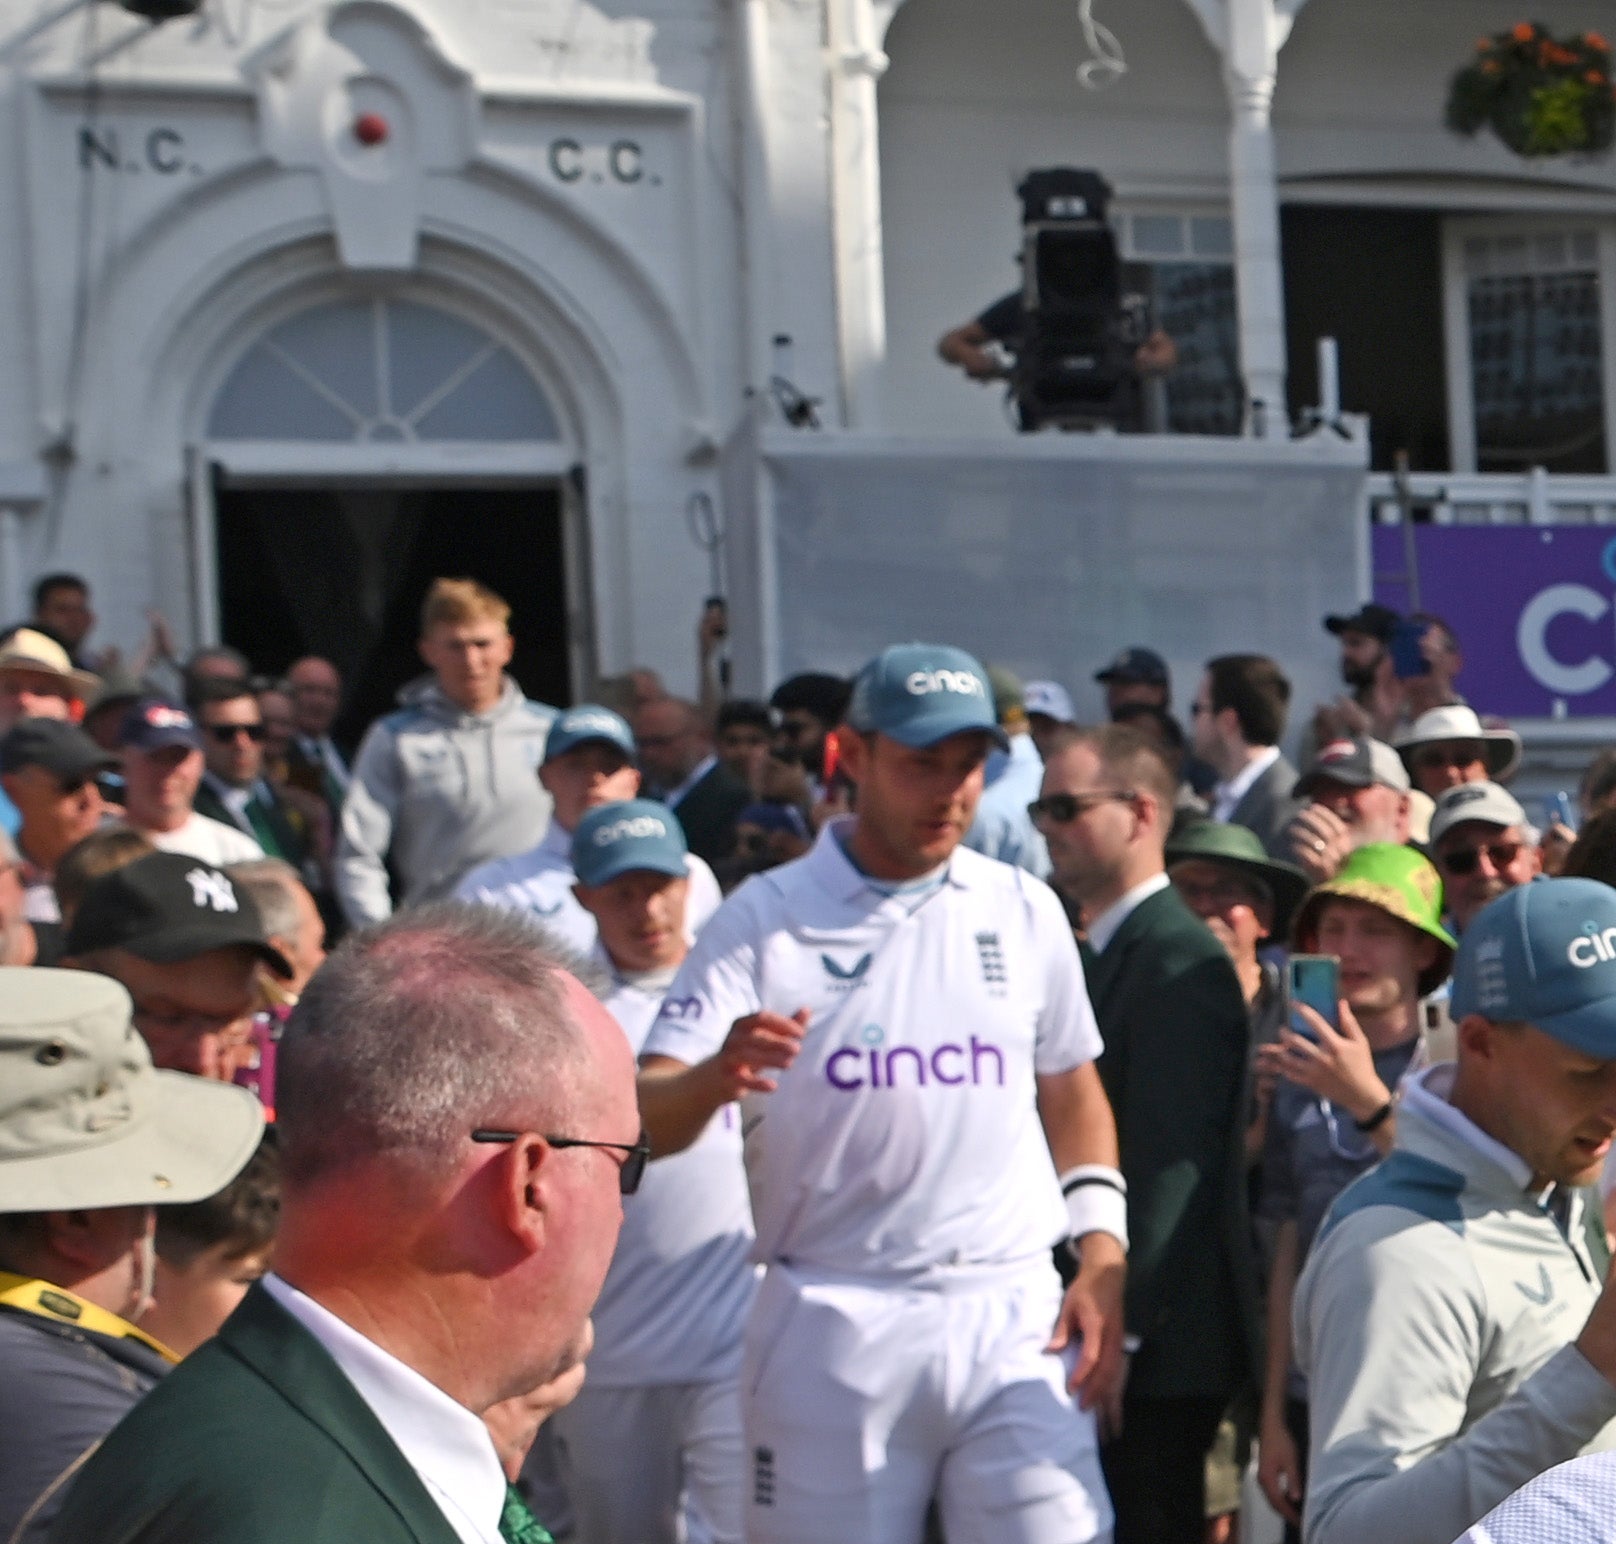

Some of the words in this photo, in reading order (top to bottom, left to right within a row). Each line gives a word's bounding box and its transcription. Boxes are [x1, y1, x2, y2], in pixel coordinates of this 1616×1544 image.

[78, 128, 200, 174] N.C.
[546, 137, 662, 186] C.C.
[906, 662, 985, 696] cinch
[825, 1023, 1004, 1091] cinch
